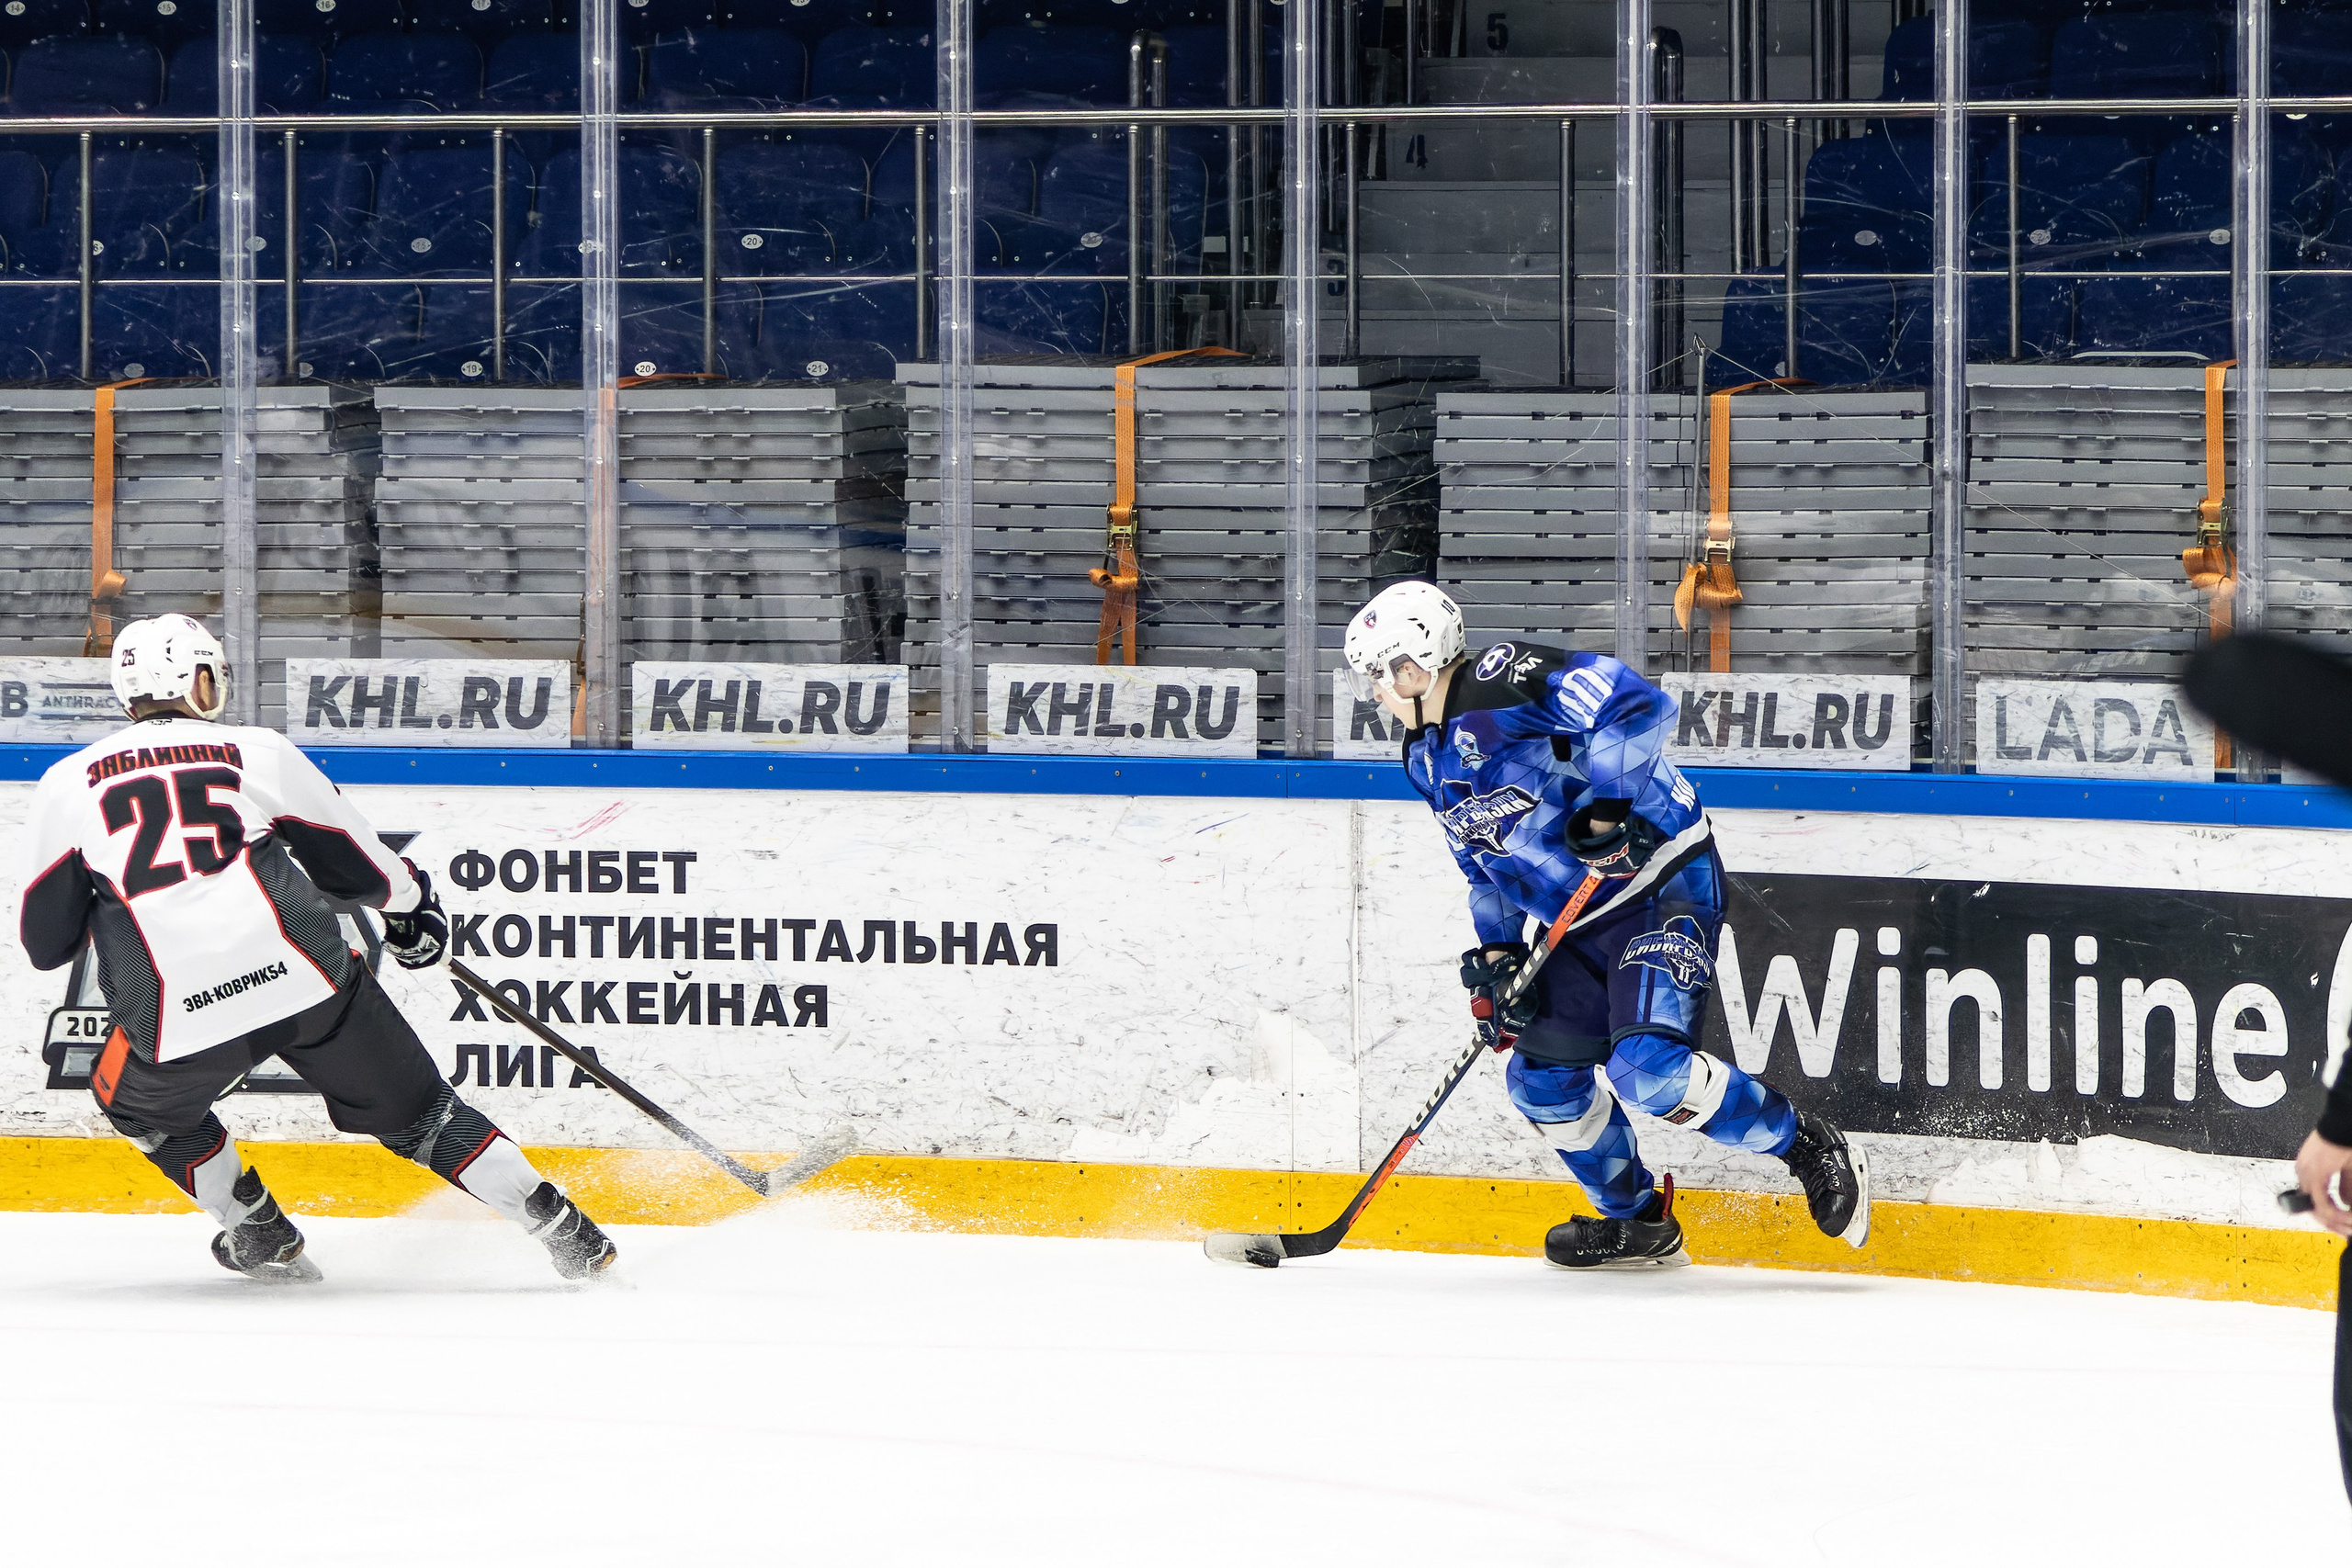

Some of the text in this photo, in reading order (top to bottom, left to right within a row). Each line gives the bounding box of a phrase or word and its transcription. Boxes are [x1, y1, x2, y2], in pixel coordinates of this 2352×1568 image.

[1486, 12, 1509, 51] 5
[120, 648, 137, 667] 25
[1376, 641, 1400, 659] CCM
[306, 675, 551, 729] KHL.RU
[650, 679, 890, 735] KHL.RU
[1004, 682, 1240, 739] KHL.RU
[1676, 690, 1894, 750] KHL.RU
[1995, 694, 2194, 766] LADA
[98, 766, 246, 901] 25
[449, 848, 697, 895] ФОНБЕТ
[1561, 884, 1593, 924] COVERT
[451, 913, 1059, 967] КОНТИНЕНТАЛЬНАЯ
[183, 961, 288, 1012] ЭВА-КОВРИК54
[448, 970, 828, 1028] ХОККЕЙНАЯ
[1714, 922, 2290, 1110] Winline
